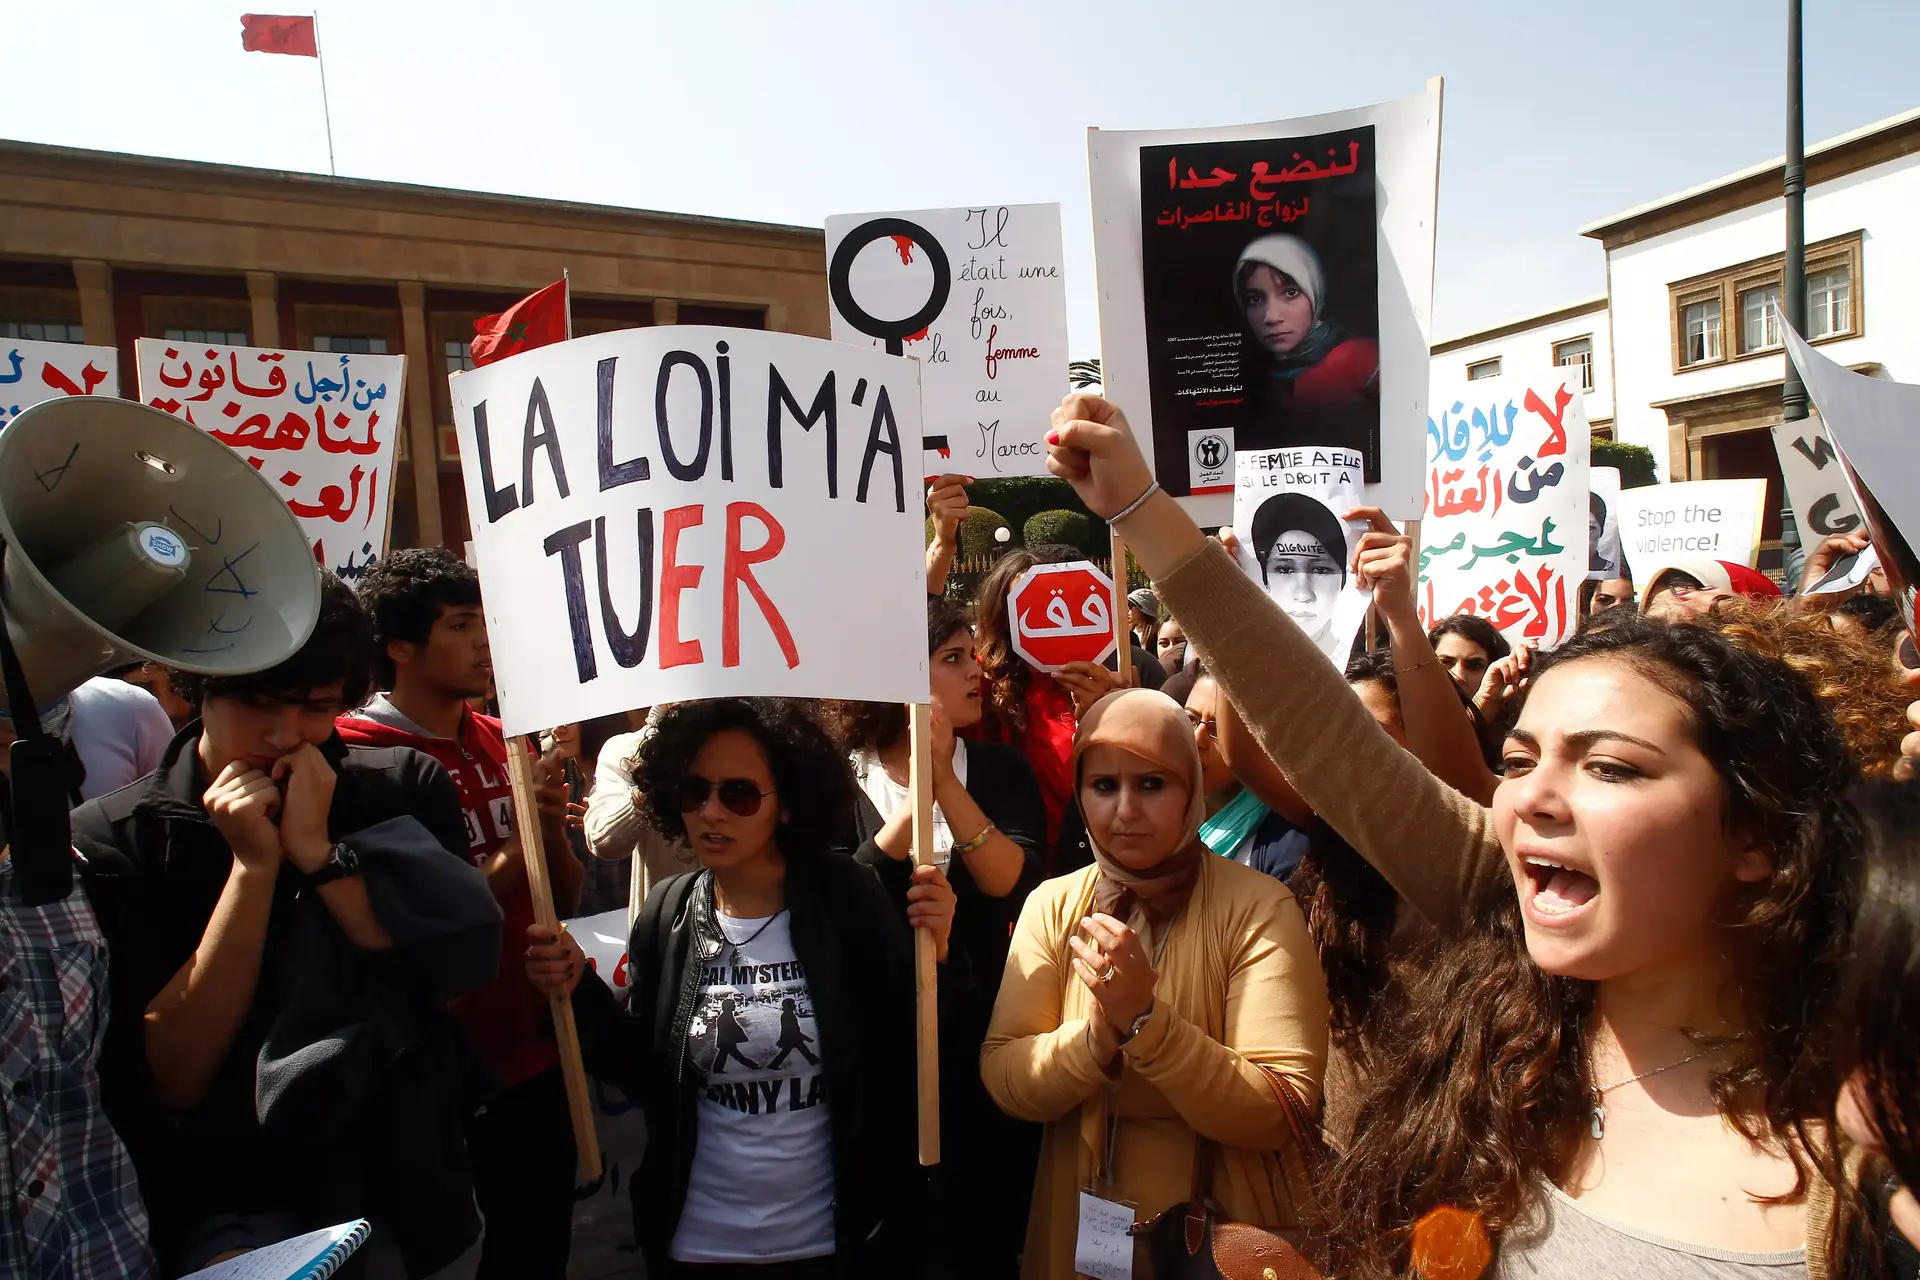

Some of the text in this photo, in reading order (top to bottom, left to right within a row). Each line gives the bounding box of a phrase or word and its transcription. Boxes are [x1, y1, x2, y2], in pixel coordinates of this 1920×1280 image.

[1168, 140, 1359, 200] لنضع حدا
[965, 207, 1008, 249] Il
[1157, 197, 1309, 229] لزواج القاصرات
[957, 255, 1059, 282] était une
[970, 287, 1013, 340] fois,
[928, 325, 1040, 380] la femme
[159, 347, 387, 411] من أجل قانون
[975, 389, 1002, 403] au
[1427, 399, 1519, 463] للإفلا
[1524, 382, 1574, 458] لا
[473, 376, 570, 523] LA
[767, 370, 905, 513] M'A
[1331, 453, 1361, 469] ELLE
[247, 455, 378, 530] العن
[1262, 475, 1277, 487] LE
[1285, 472, 1330, 485] DROIT
[1339, 471, 1351, 484] A
[1508, 455, 1564, 504] من
[1638, 504, 1722, 528] Stop the
[1276, 541, 1326, 554] DIGNITÉ
[1636, 533, 1719, 553] violence!
[543, 502, 800, 683] TUER
